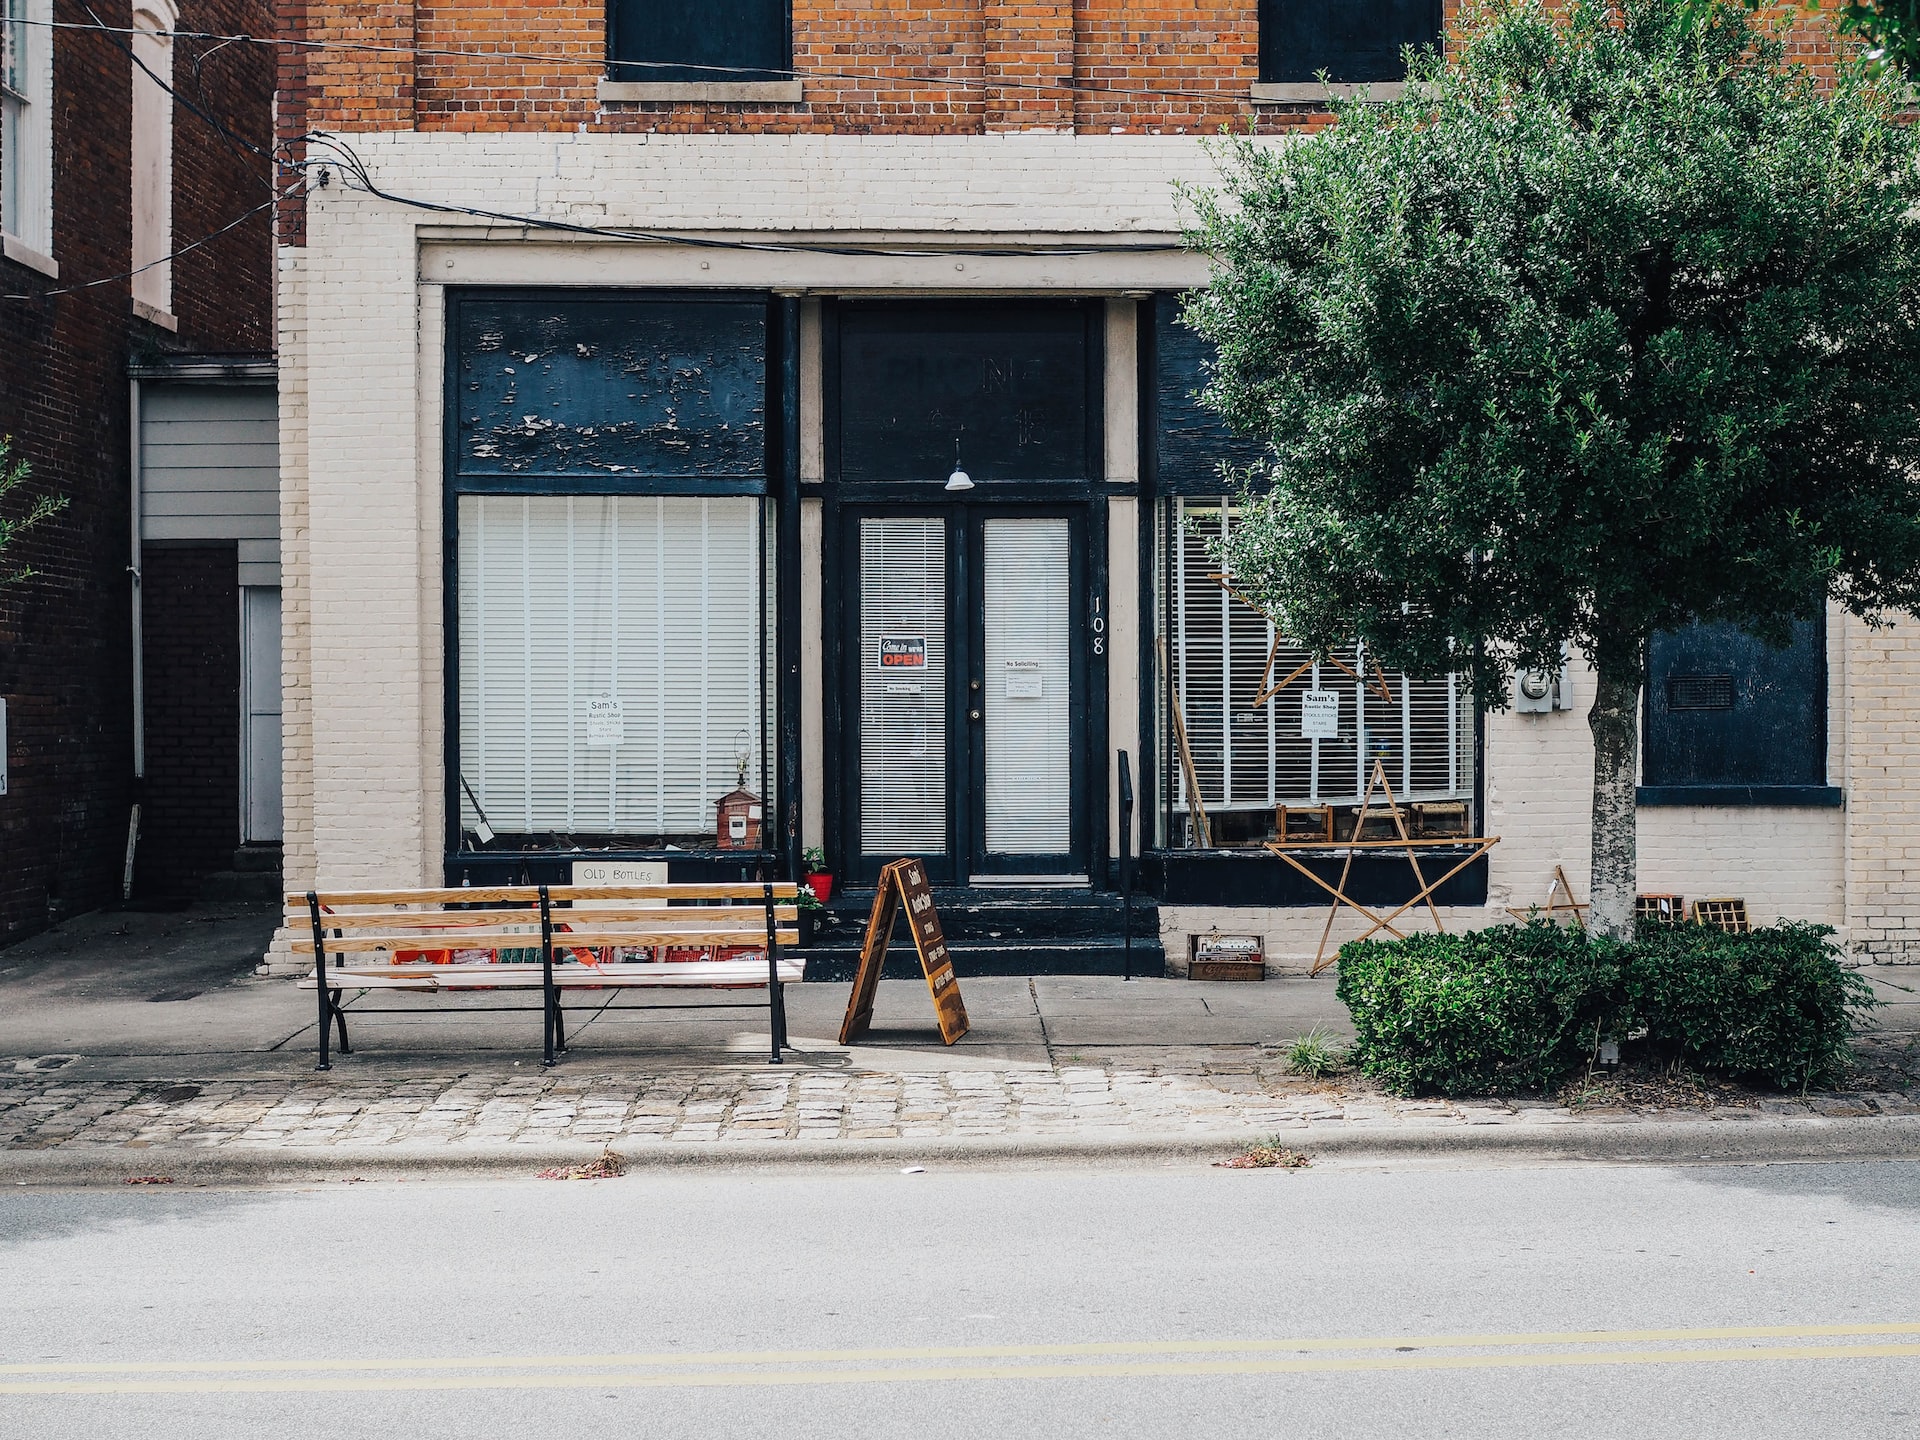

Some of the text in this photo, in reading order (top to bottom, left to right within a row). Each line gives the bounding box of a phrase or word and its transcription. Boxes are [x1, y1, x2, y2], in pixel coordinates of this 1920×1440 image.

[883, 654, 923, 665] OPEN
[591, 701, 618, 709] Sam's
[584, 868, 653, 881] OLD BOTTLES
